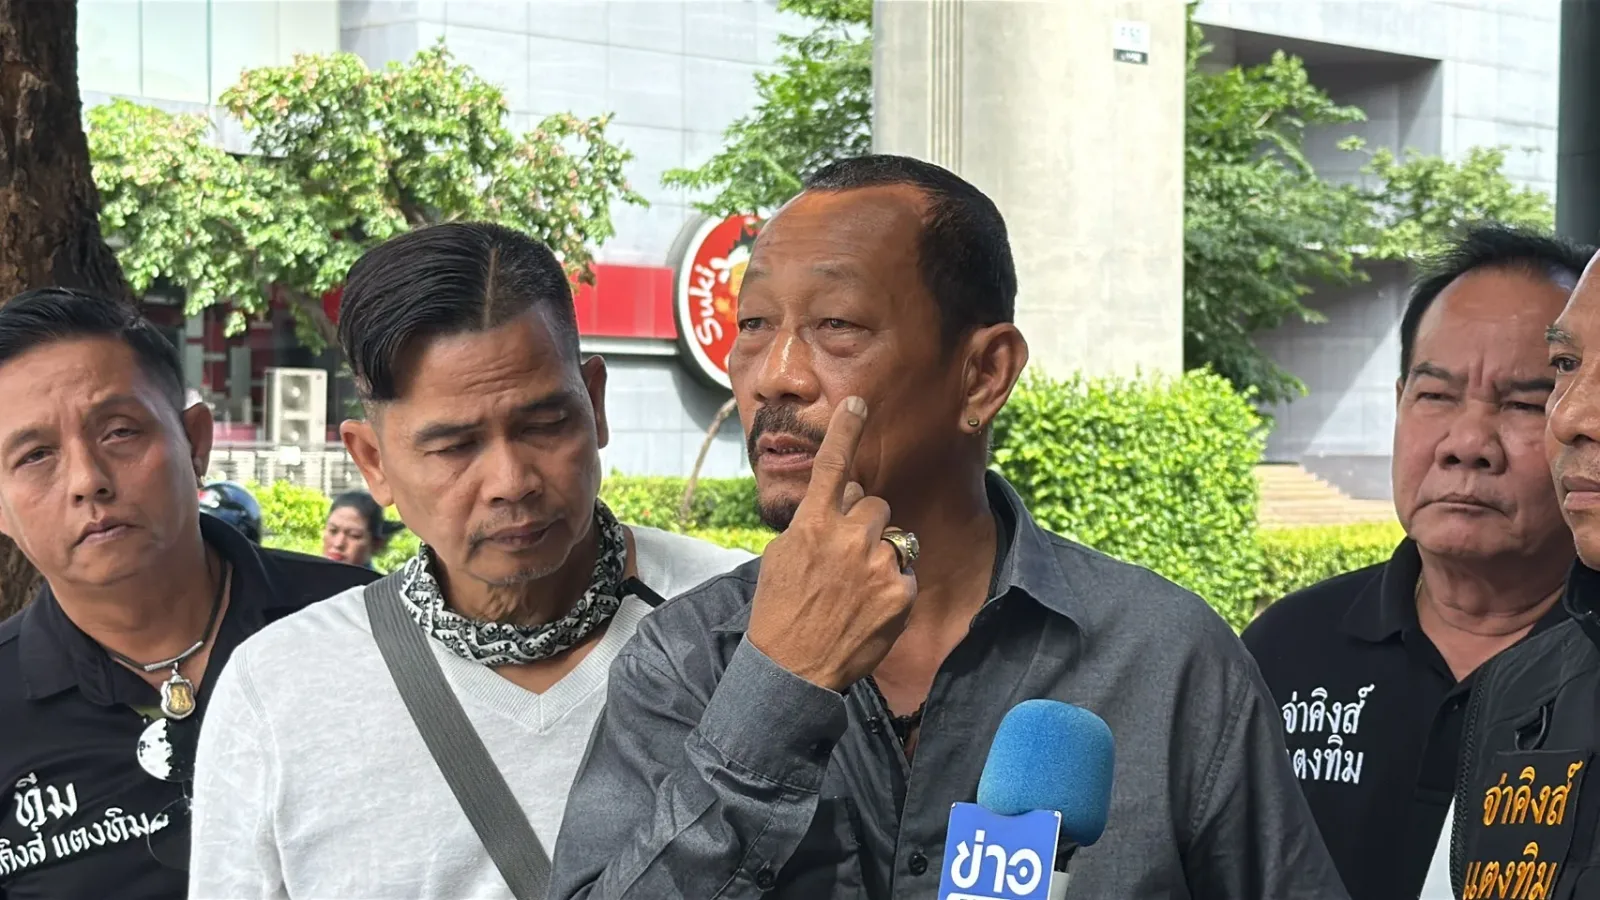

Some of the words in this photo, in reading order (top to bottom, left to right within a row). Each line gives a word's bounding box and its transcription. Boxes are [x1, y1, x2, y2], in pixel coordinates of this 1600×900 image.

[689, 264, 723, 346] Suki
[1281, 684, 1375, 734] จ่าคิงส์
[1286, 734, 1364, 784] ตงทิม
[14, 772, 78, 827] ทีม
[1483, 760, 1584, 826] จ่าคิงส์
[950, 829, 1042, 896] ข่าว
[1463, 841, 1557, 900] แตงทิม
